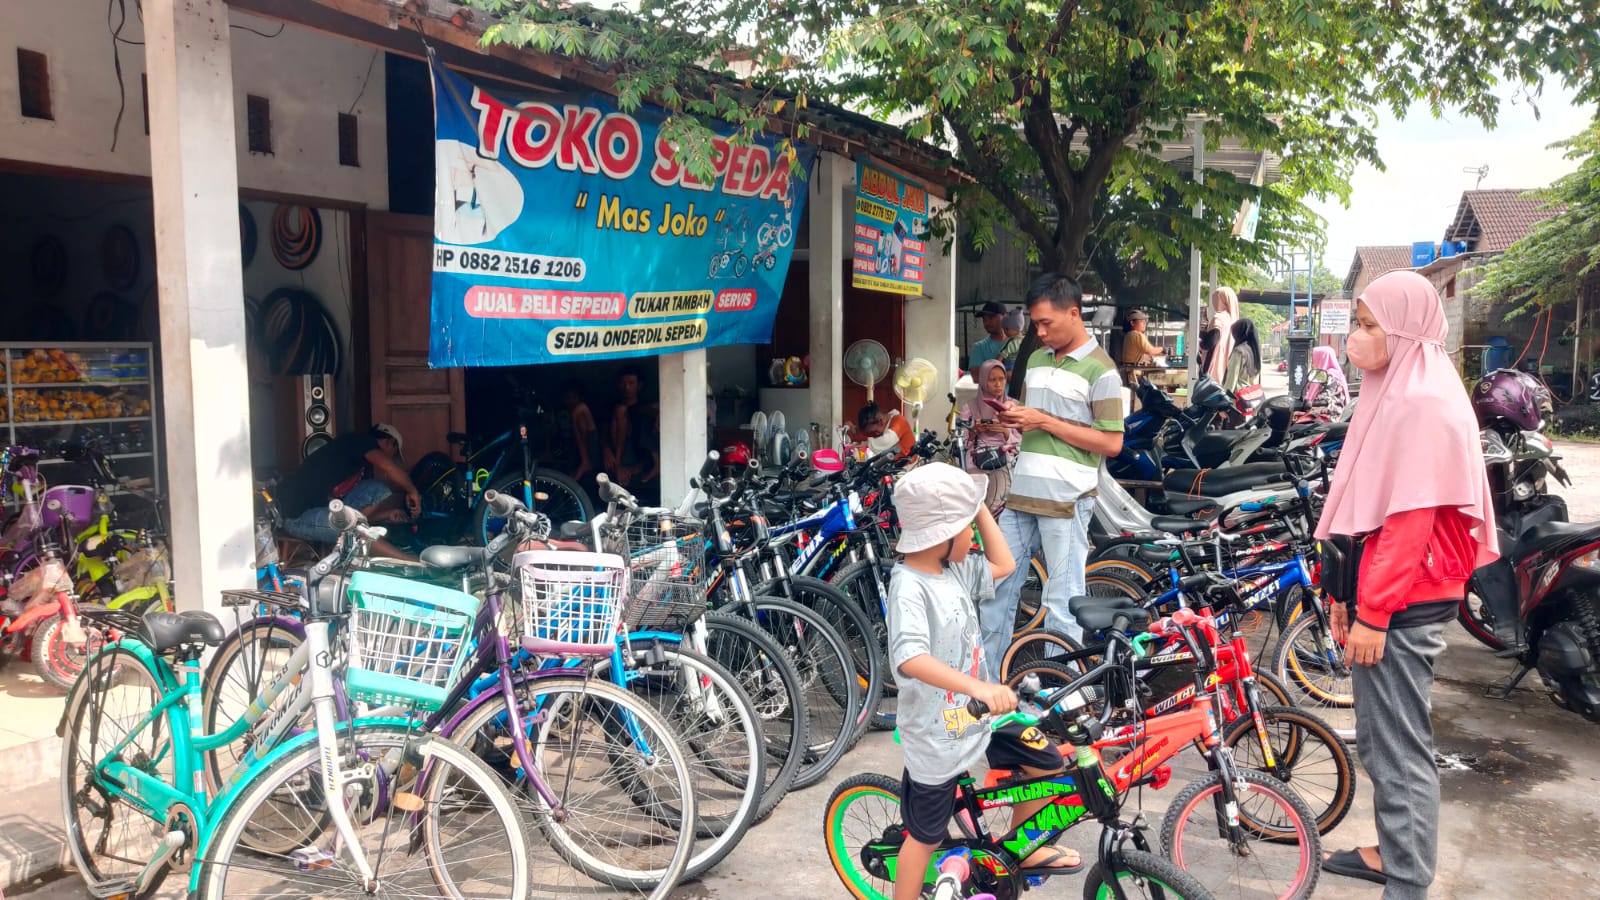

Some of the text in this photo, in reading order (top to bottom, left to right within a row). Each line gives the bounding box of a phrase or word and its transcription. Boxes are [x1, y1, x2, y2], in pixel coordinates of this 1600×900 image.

[471, 85, 643, 180] TOKO
[596, 194, 651, 233] Mas
[657, 203, 708, 237] Joko
[436, 248, 582, 278] HP 0882 2516 1206
[474, 291, 620, 315] JUAL BELI SEPEDA
[634, 294, 711, 313] TUKAR TAMBAH
[718, 292, 752, 308] SERVIS
[554, 323, 702, 349] SEDIA ONDERDIL SEPEDA
